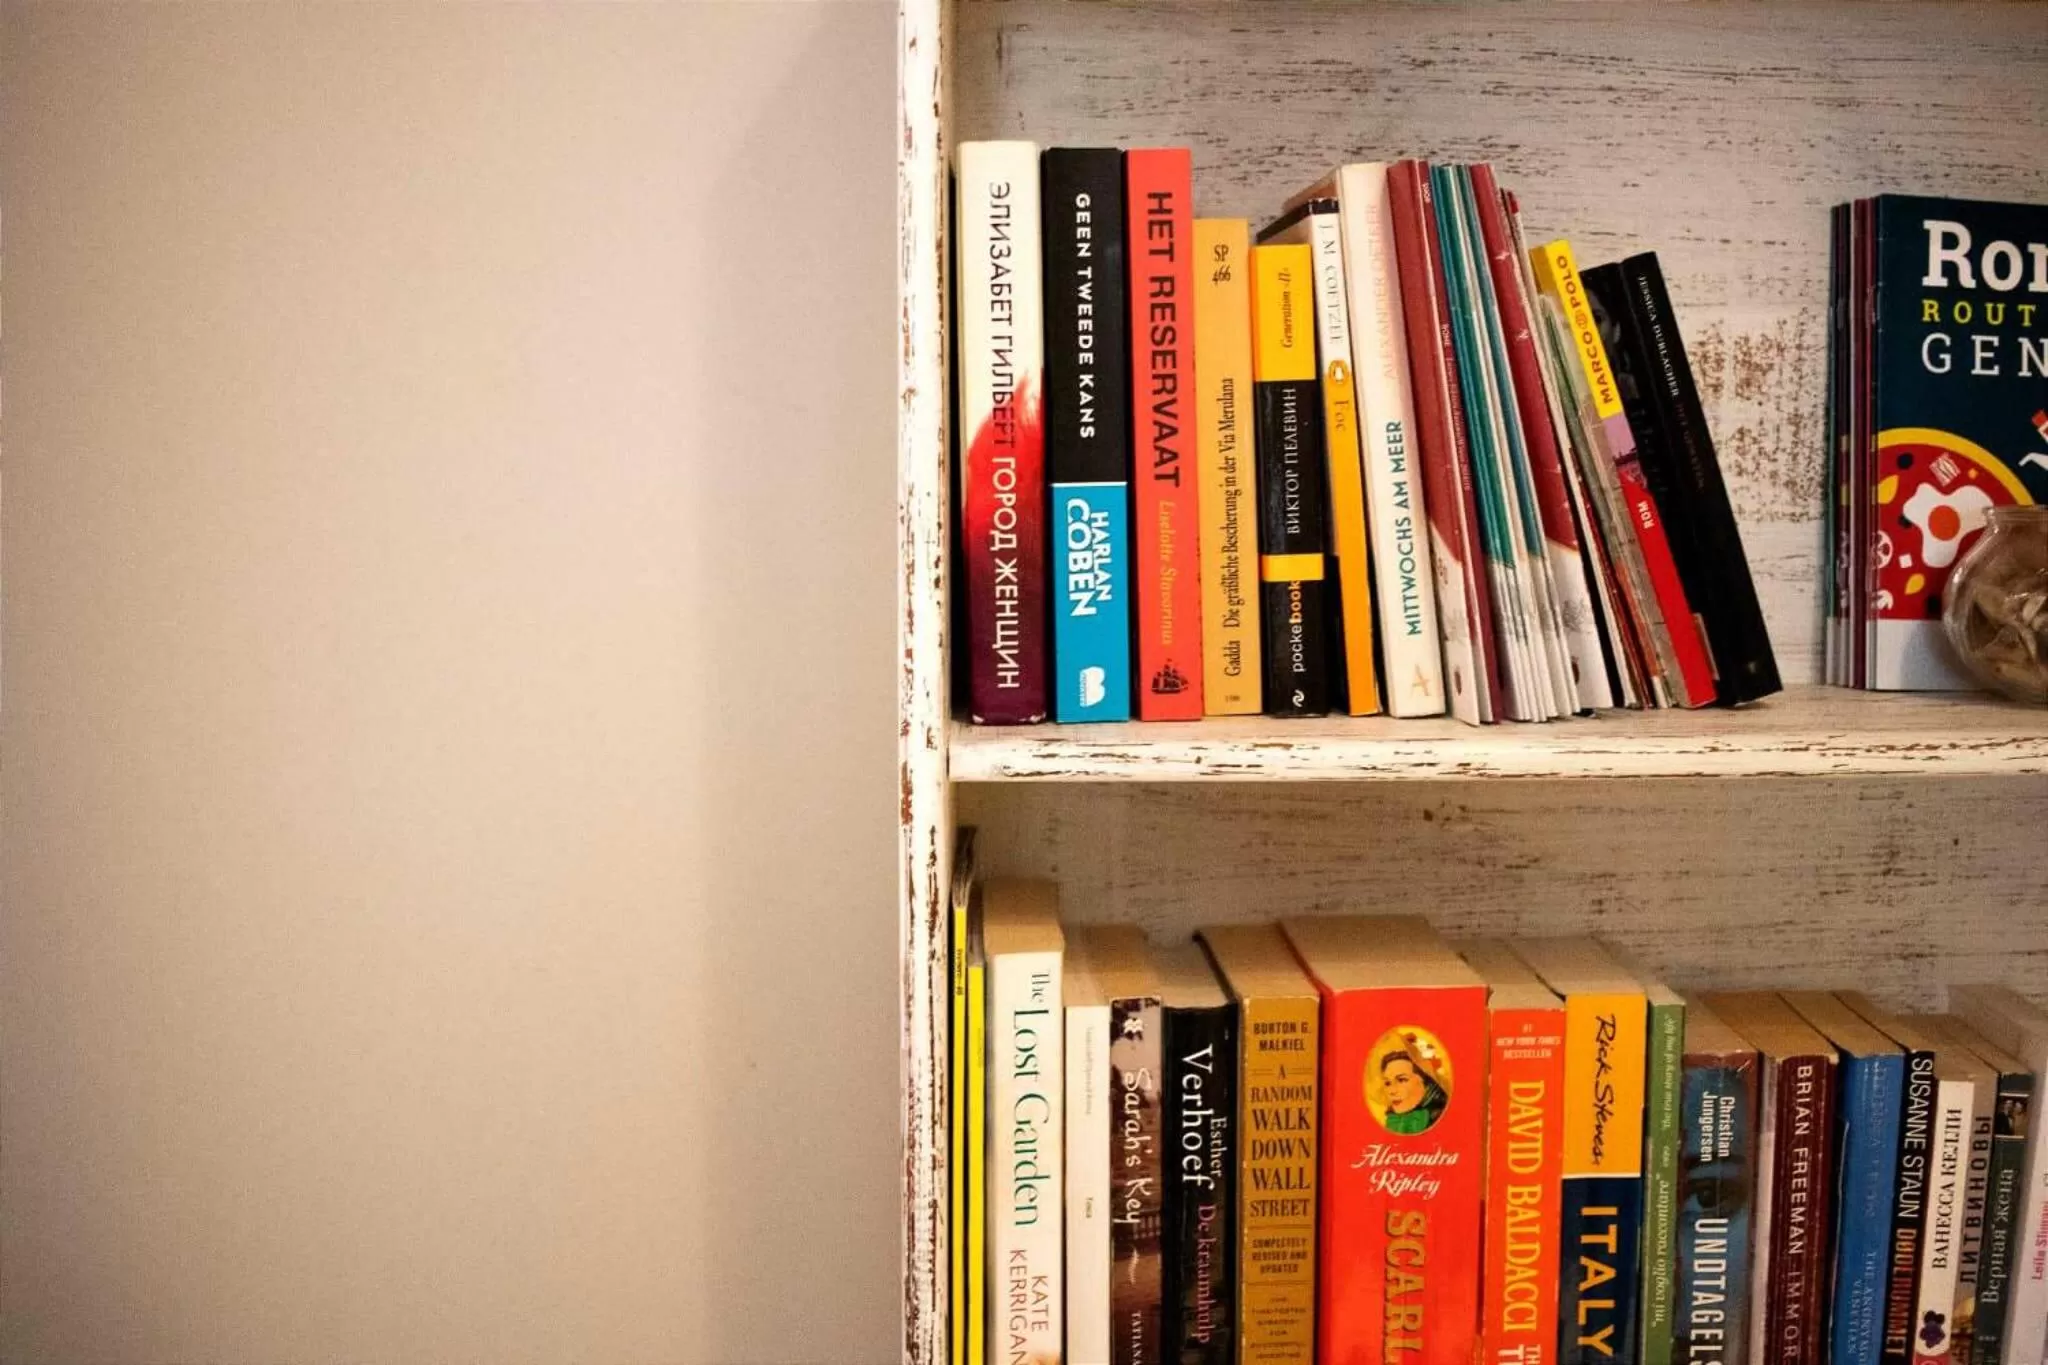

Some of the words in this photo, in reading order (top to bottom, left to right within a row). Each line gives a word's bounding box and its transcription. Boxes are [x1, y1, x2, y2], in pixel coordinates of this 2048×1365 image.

[989, 181, 1013, 326] ЭЛИЗАБЕТ
[1075, 193, 1092, 257] GEEN
[1147, 192, 1174, 262] HET
[1213, 244, 1229, 262] SP
[1212, 265, 1231, 286] 466
[1326, 264, 1343, 344] COETZEE
[1555, 254, 1583, 309] POLO
[1076, 266, 1094, 365] TWEEDE
[1637, 274, 1657, 321] JESSICA
[1652, 323, 1680, 398] DURLACHER
[1922, 299, 2036, 327] ROUT
[991, 334, 1016, 448] ГИЛЬБЕРТ
[1149, 276, 1181, 488] RESERVAAT
[1583, 330, 1613, 404] MARCO
[1079, 374, 1095, 439] KANS
[1216, 378, 1235, 431] Merulana
[1283, 388, 1299, 464] ПЕЛЕВИН
[1217, 456, 1236, 473] der
[1218, 434, 1236, 453] Via
[1386, 421, 1406, 473] MEER
[990, 457, 1017, 551] ГОРОД
[1219, 489, 1242, 553] Bescherung
[1284, 470, 1301, 534] ВИКТОР
[1393, 481, 1409, 509] AM
[1637, 501, 1653, 530] ROM
[1066, 498, 1097, 617] COBEN
[1090, 511, 1112, 601] HARLAN
[1395, 516, 1421, 635] MITTWOCHS
[992, 558, 1020, 688] ЖЕНЩИН
[1221, 608, 1240, 628] Die
[1289, 580, 1304, 673] pocketbook
[1224, 641, 1240, 676] Gadda
[1031, 973, 1050, 1003] The
[1014, 1010, 1049, 1079] Lost
[1253, 1022, 1296, 1035] BURTON
[1259, 1039, 1306, 1052] MALKIEL
[1595, 1013, 1616, 1077] Rick
[1250, 1084, 1313, 1102] RANDOM
[1278, 1065, 1286, 1080] A
[1793, 1064, 1812, 1136] BRIAN
[1905, 1057, 1933, 1150] SUSANNE
[1124, 1068, 1152, 1167] Sarah's
[1181, 1044, 1215, 1190] Verhoef
[1209, 1116, 1228, 1177] Esther
[1252, 1108, 1311, 1131] WALK
[1507, 1080, 1545, 1174] DAVID
[1592, 1078, 1615, 1165] Steves
[1700, 1091, 1718, 1162] Jungersen
[1717, 1096, 1736, 1158] Christian
[1014, 1093, 1051, 1226] Garden
[1251, 1139, 1311, 1161] DOWN
[1252, 1168, 1310, 1191] WALL
[1350, 1143, 1459, 1169] Alexandra
[1114, 1177, 1152, 1224] Key
[1250, 1199, 1310, 1217] STREET
[1370, 1170, 1441, 1200] Ripley
[1787, 1148, 1809, 1254] FREEMAN
[1898, 1155, 1925, 1219] STAUN
[1932, 1183, 1955, 1269] ВАНЕССА
[1947, 1109, 1963, 1178] КЕЛЛИ
[1960, 1116, 1991, 1284] ЛИТВИНОВЫ
[1197, 1204, 1216, 1231] De
[1981, 1226, 2008, 1304] Верная
[1997, 1169, 2014, 1222] жена
[1191, 1236, 1217, 1344] kraamhulp
[1384, 1210, 1426, 1365] SCARL
[1503, 1185, 1542, 1332] BALDACCI
[1577, 1206, 1618, 1356] ITALY
[2031, 1250, 2046, 1281] Leila
[1009, 1250, 1028, 1365] KERRIGAN
[1031, 1276, 1049, 1332] KATE
[1858, 1283, 1874, 1365] ANONYMO
[1498, 1344, 1524, 1365] T
